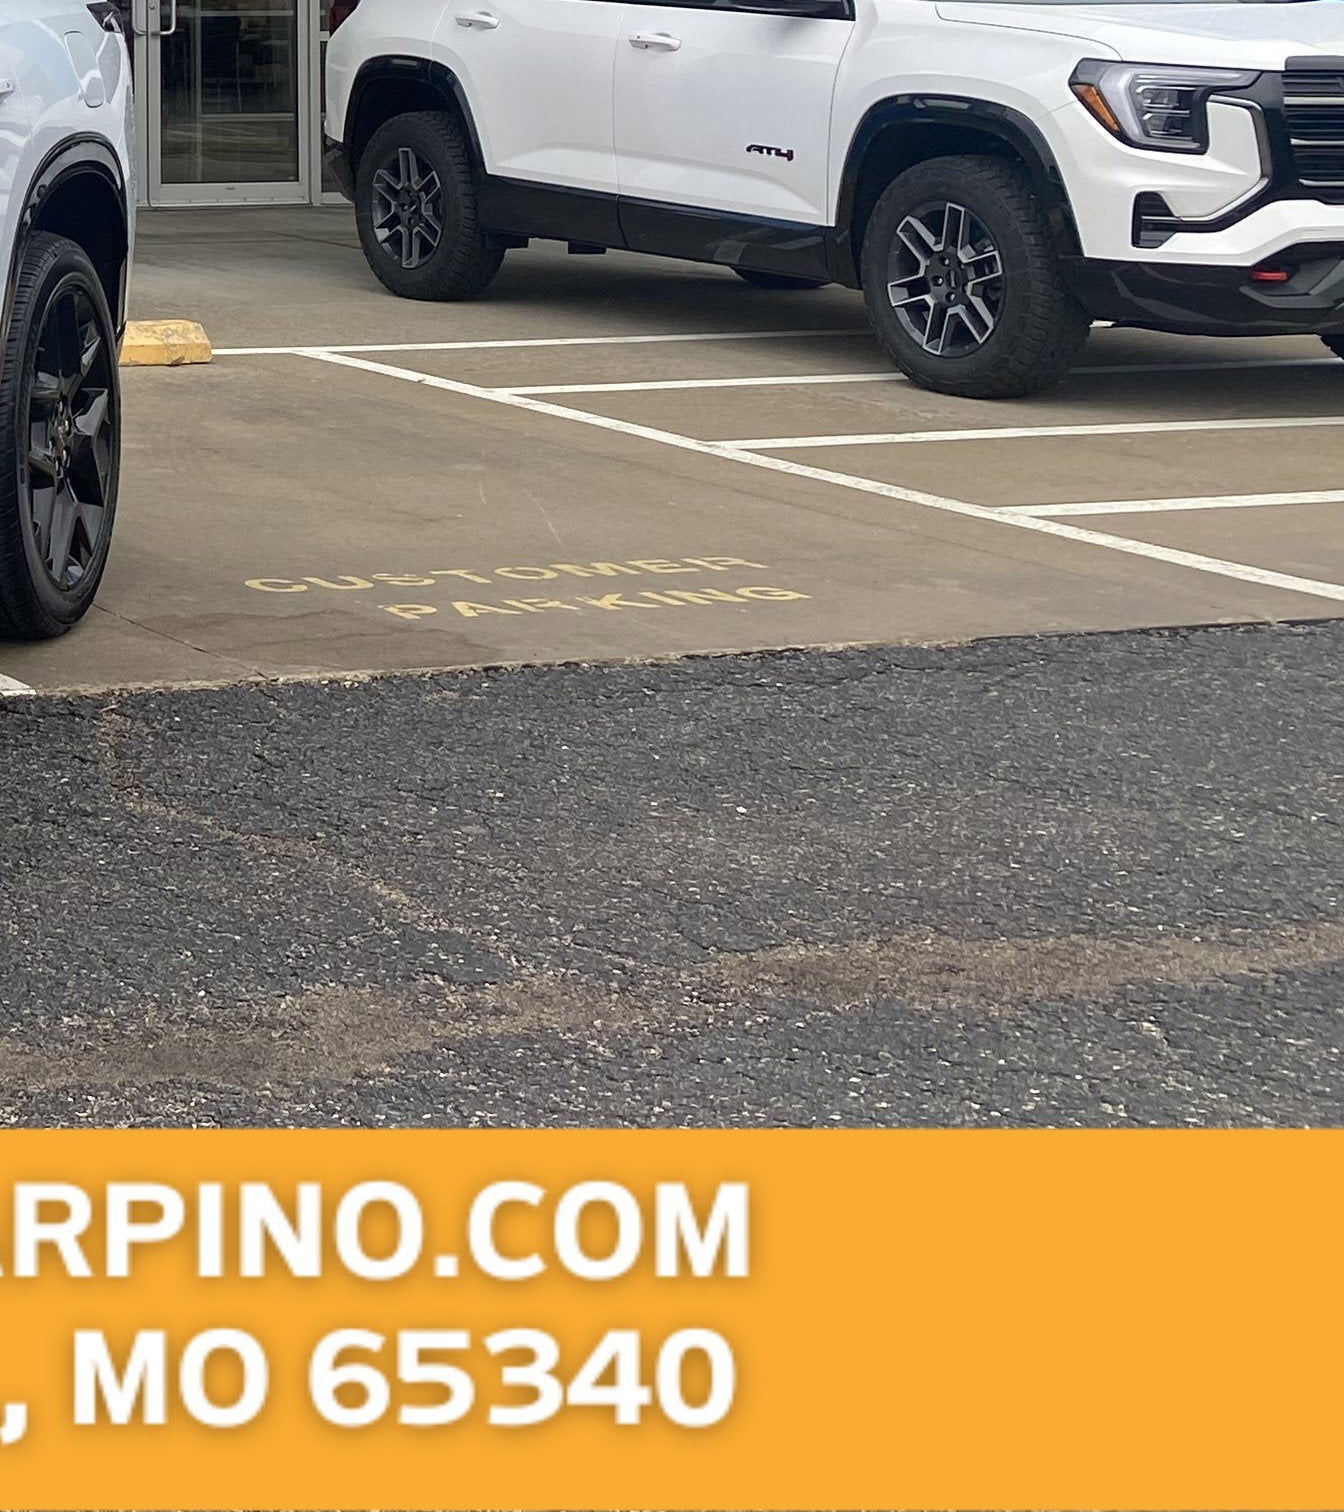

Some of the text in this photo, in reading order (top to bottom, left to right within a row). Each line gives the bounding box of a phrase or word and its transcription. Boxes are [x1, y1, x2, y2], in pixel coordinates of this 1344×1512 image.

[745, 143, 794, 161] AT4
[244, 555, 770, 595] CUSTOMER
[377, 584, 812, 620] PARKING
